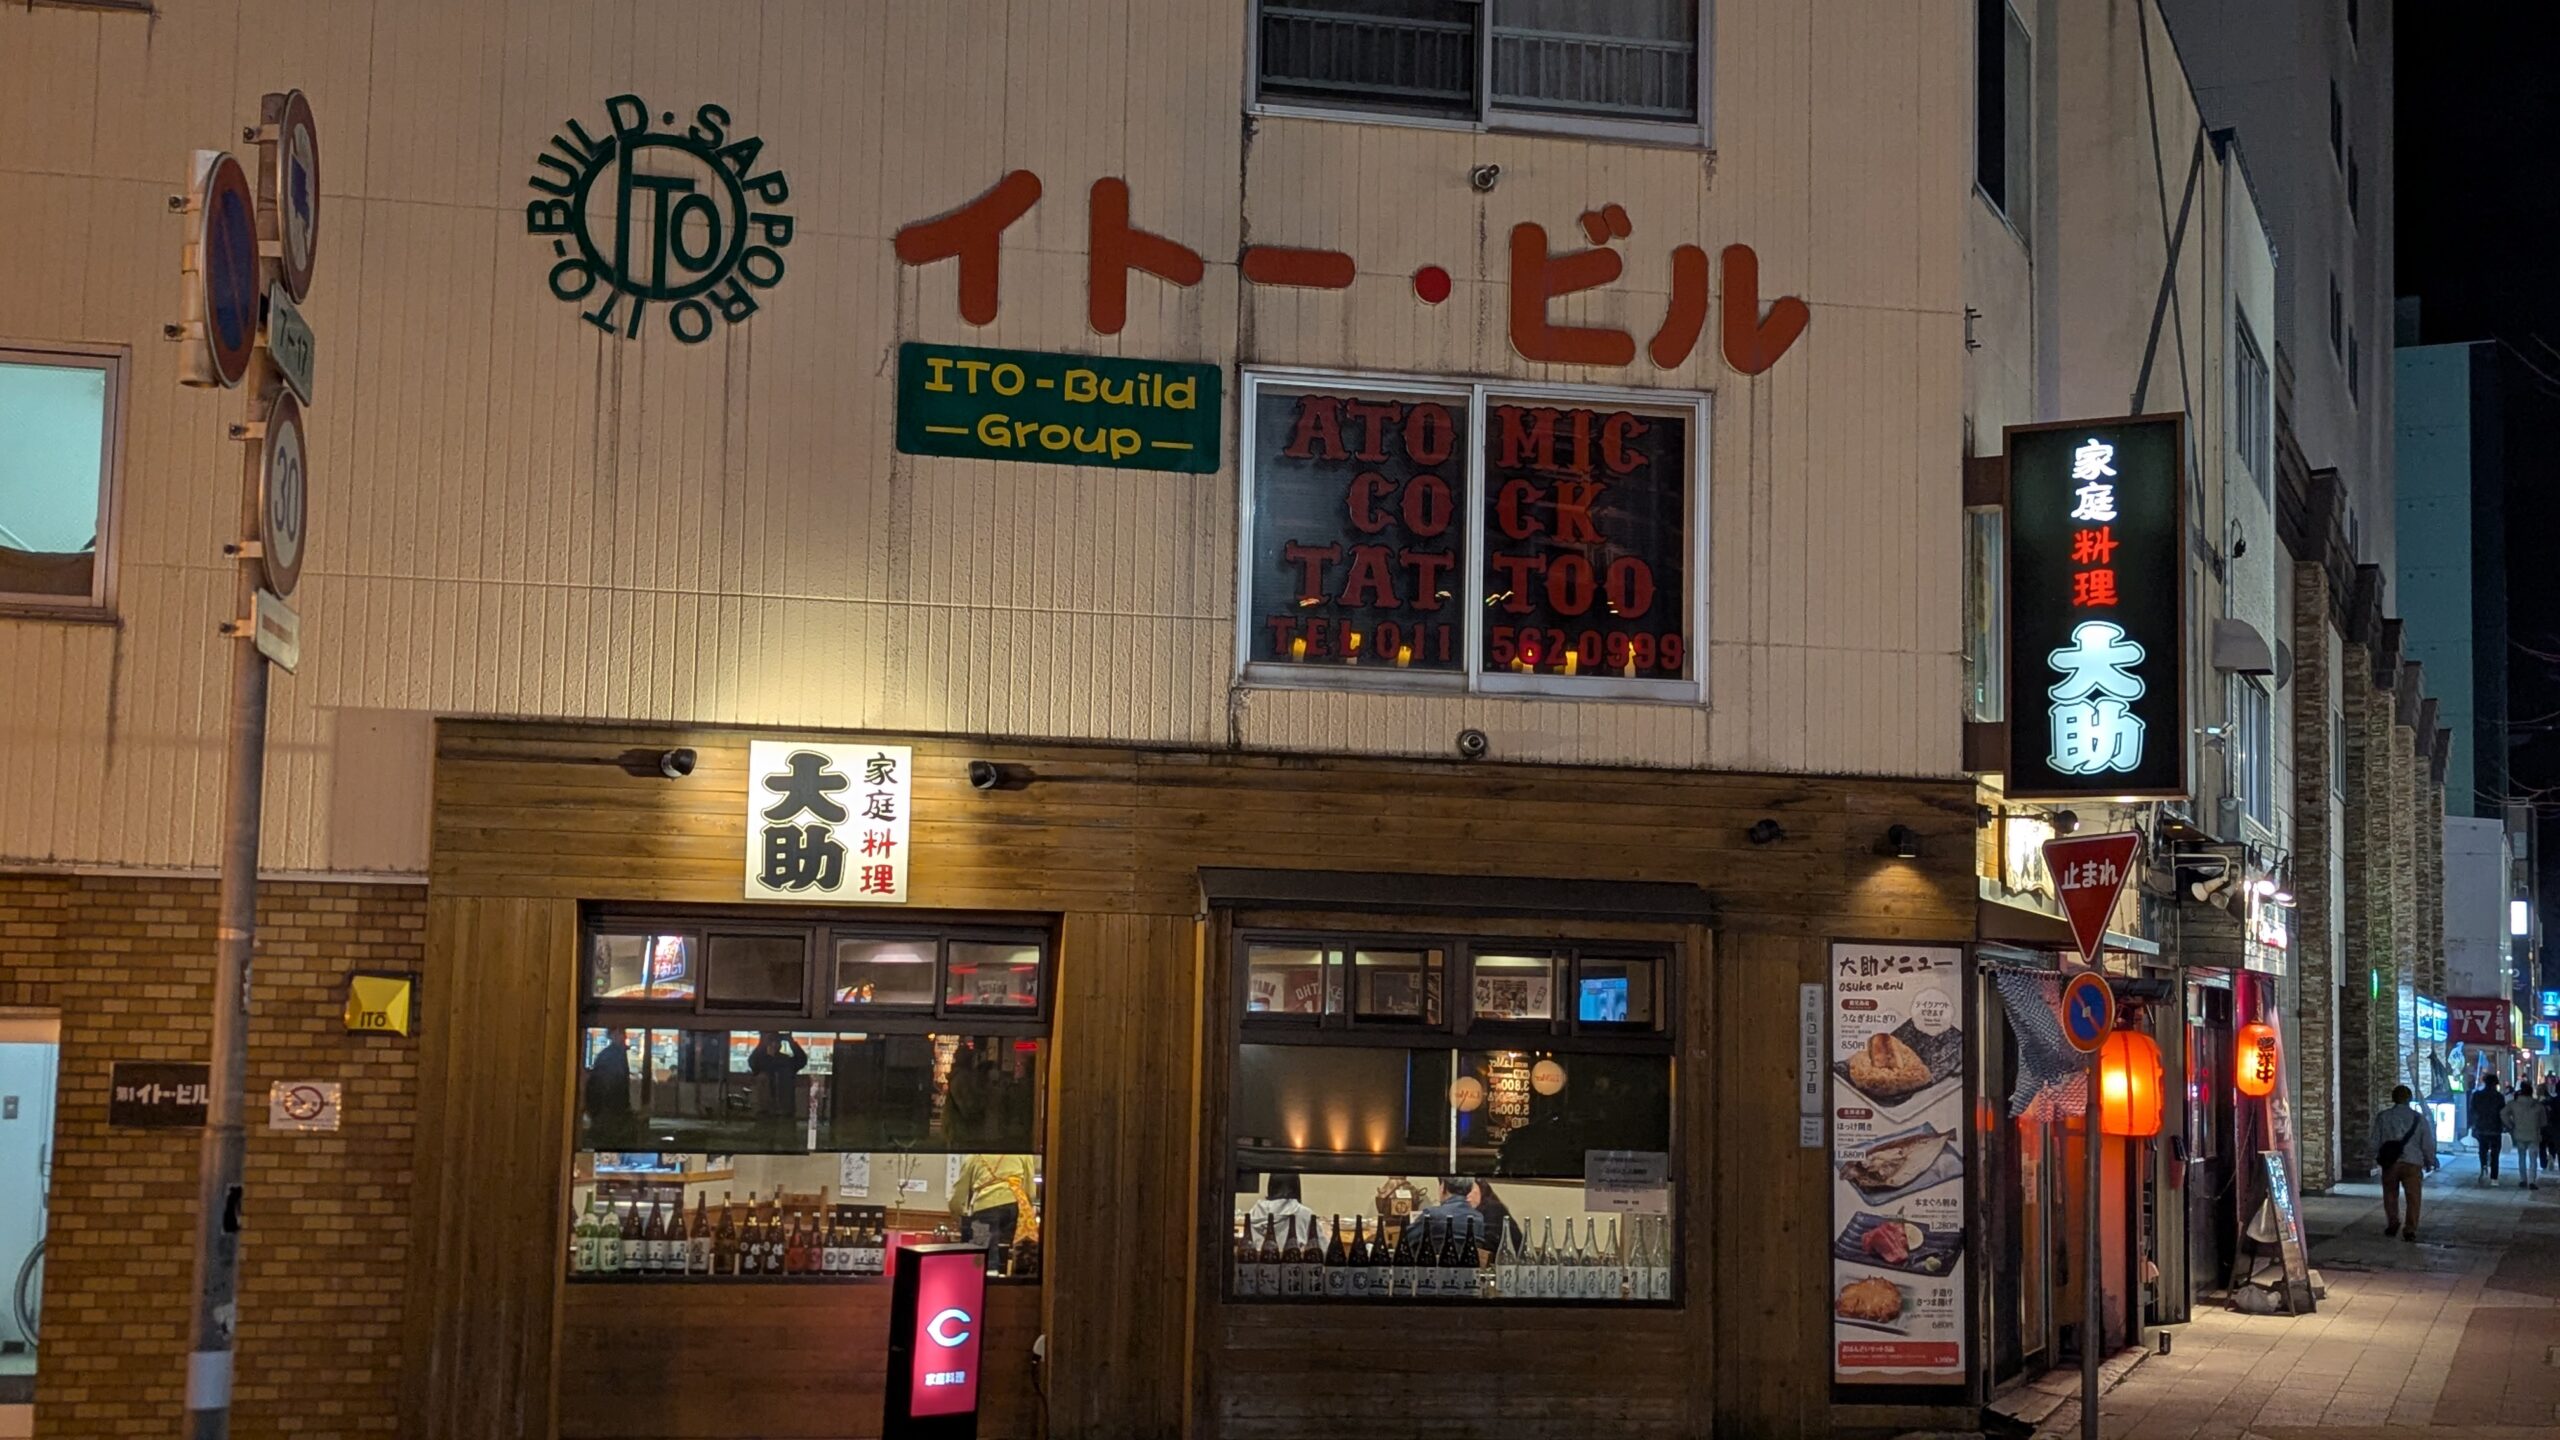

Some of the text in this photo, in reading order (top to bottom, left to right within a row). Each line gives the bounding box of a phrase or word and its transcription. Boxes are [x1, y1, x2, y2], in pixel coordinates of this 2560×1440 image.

[669, 102, 794, 344] SAPPORO
[894, 169, 1810, 376] イトー・ビル
[976, 413, 1142, 461] Group
[274, 445, 300, 543] 30
[2070, 438, 2120, 608] 家庭料理
[2046, 620, 2147, 775] 大助
[757, 750, 851, 893] 大助
[860, 752, 898, 895] 家庭料理
[2060, 857, 2119, 891] 止まれ
[1838, 981, 1904, 993] osuke menu
[1839, 955, 1953, 977] 大助メニュー
[1841, 1013, 1897, 1024] うなぎおにぎり
[1841, 1041, 1866, 1050] 850円
[1837, 1122, 1872, 1131] ほっけ開き
